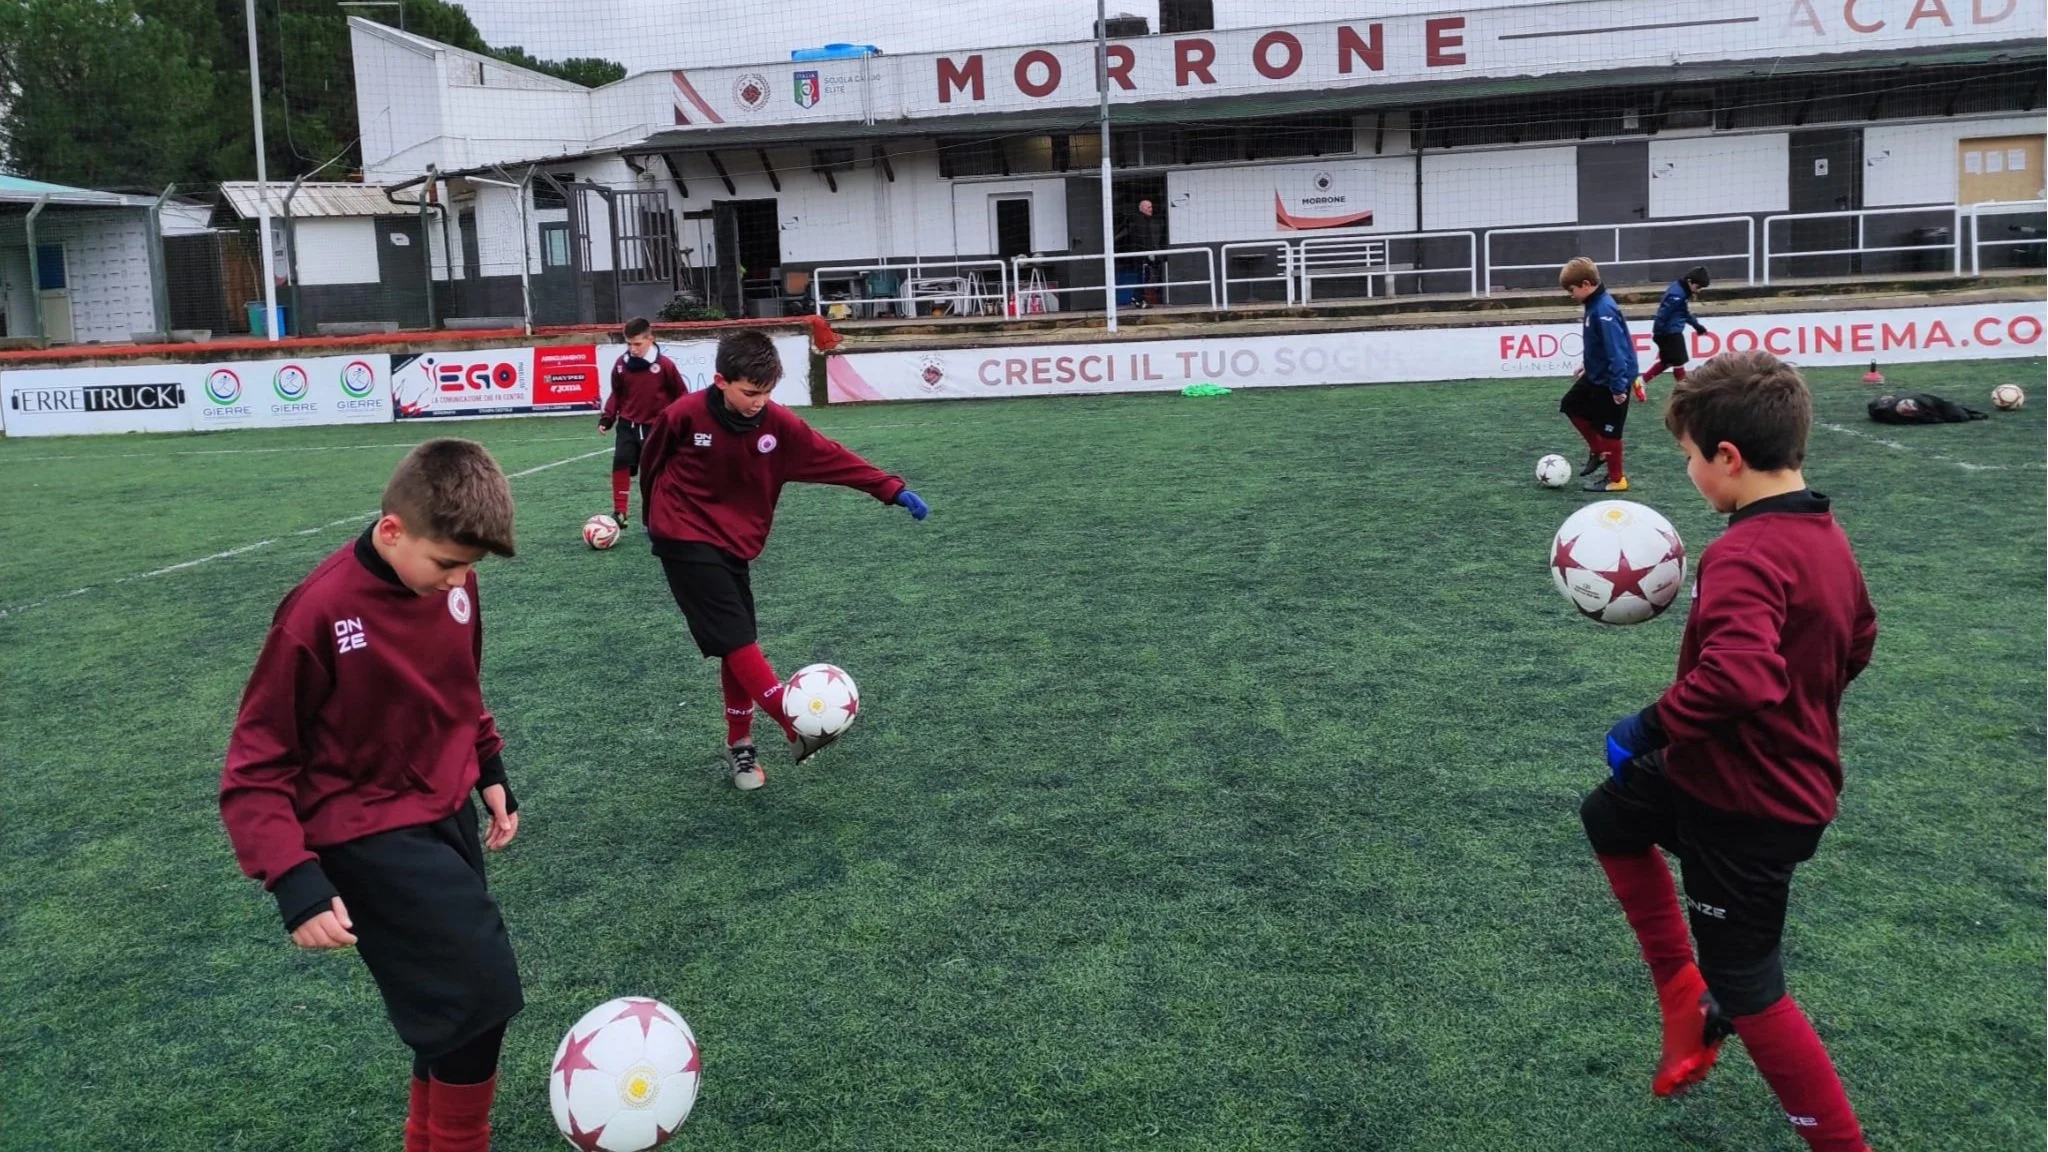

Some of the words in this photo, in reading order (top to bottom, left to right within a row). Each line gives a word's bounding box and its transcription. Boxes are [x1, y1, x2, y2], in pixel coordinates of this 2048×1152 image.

[1779, 0, 2046, 37] ACAD
[936, 16, 1467, 104] MORRONE
[824, 76, 854, 84] SCUOLA
[855, 73, 881, 83] CAIO
[1302, 195, 1346, 205] MORRONE
[1501, 332, 1584, 359] FADO
[1631, 314, 2044, 359] FDOCINEMA.CO
[978, 354, 1115, 386] CRESCI
[1130, 353, 1164, 381] IL
[1175, 349, 1260, 378] TUO
[1273, 342, 1393, 376] SOGN
[439, 362, 518, 392] EGO
[203, 406, 251, 417] GIERRE
[270, 403, 318, 413] GIERRE
[337, 399, 383, 409] GIERRE
[334, 617, 363, 637] ON
[337, 632, 367, 654] ZE
